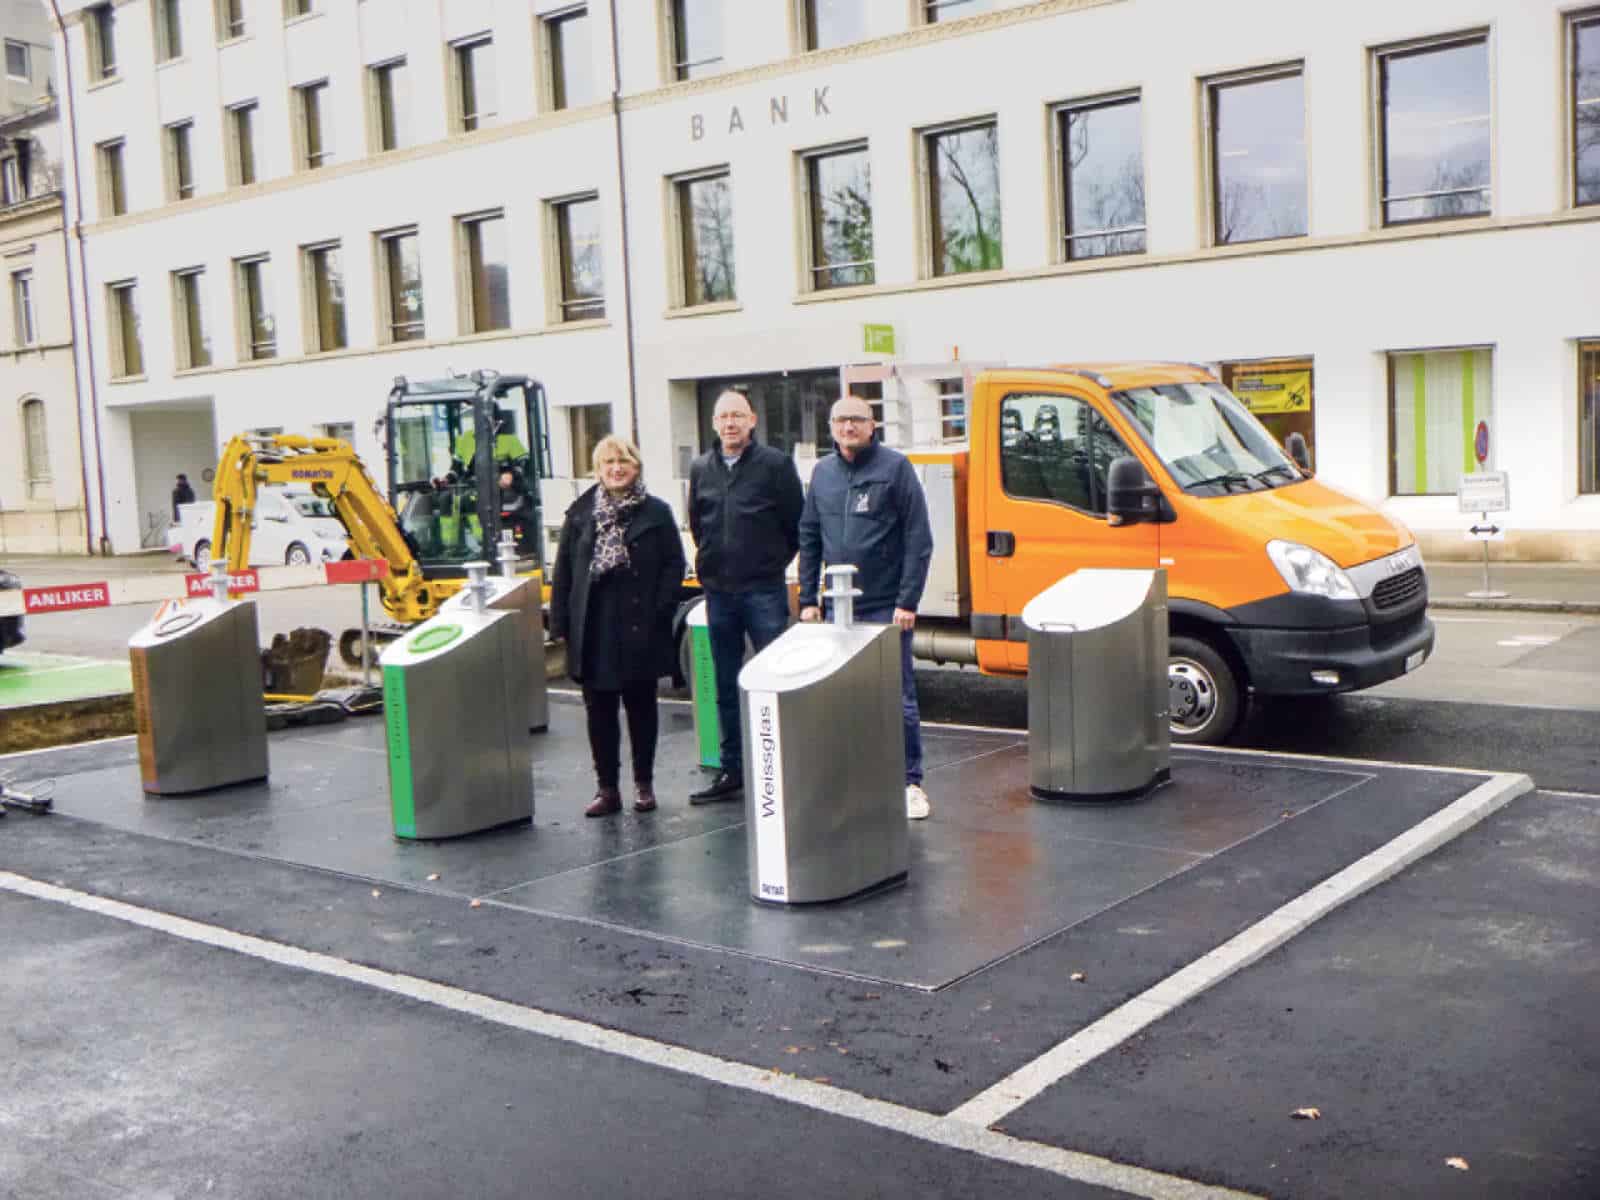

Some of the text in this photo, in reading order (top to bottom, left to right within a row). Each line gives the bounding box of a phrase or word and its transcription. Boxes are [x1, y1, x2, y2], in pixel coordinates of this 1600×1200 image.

[691, 86, 831, 141] BANK
[29, 588, 105, 608] ANLIKER
[191, 575, 255, 591] ANKER
[760, 705, 776, 818] Weissglas
